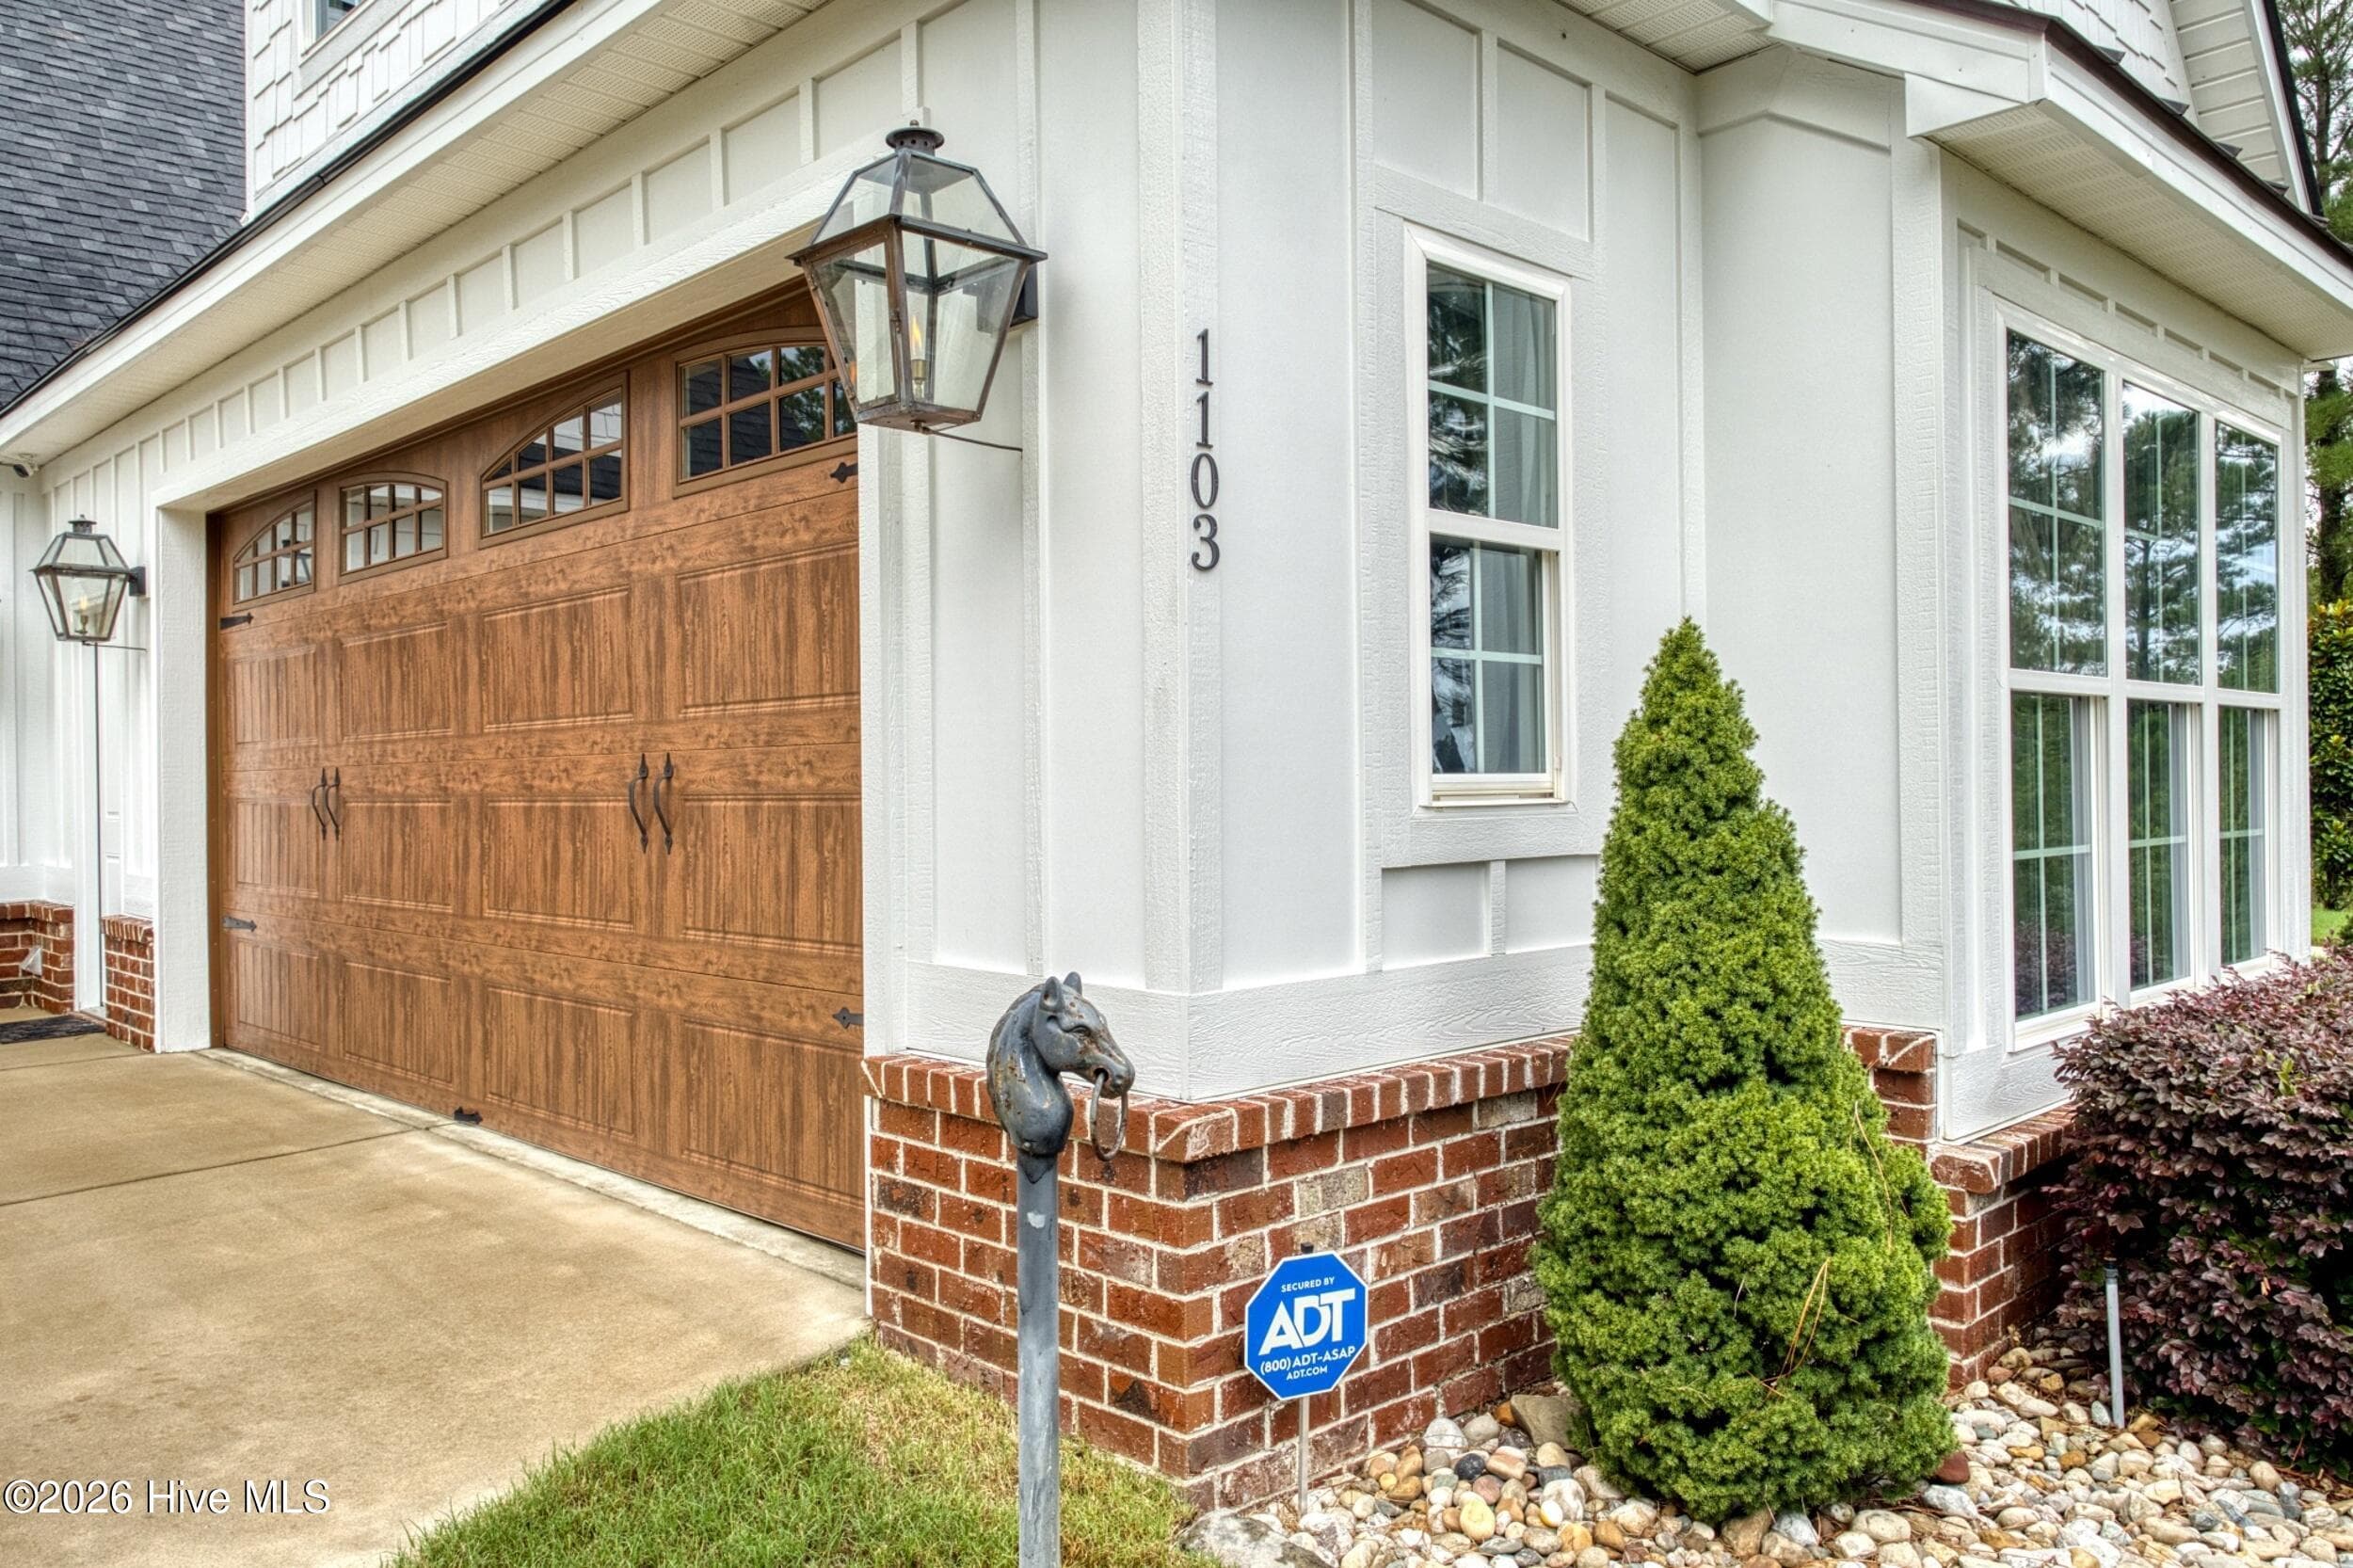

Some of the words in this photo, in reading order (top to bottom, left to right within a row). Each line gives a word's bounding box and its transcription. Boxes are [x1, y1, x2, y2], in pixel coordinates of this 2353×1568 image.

[1191, 328, 1220, 571] 1103
[1281, 1279, 1321, 1293] SECURED
[1323, 1276, 1335, 1286] BY
[1257, 1288, 1355, 1356] ADT
[1260, 1357, 1291, 1375] (800)
[1292, 1346, 1356, 1368] ADT-ASAP
[1286, 1366, 1328, 1381] ADT.COM
